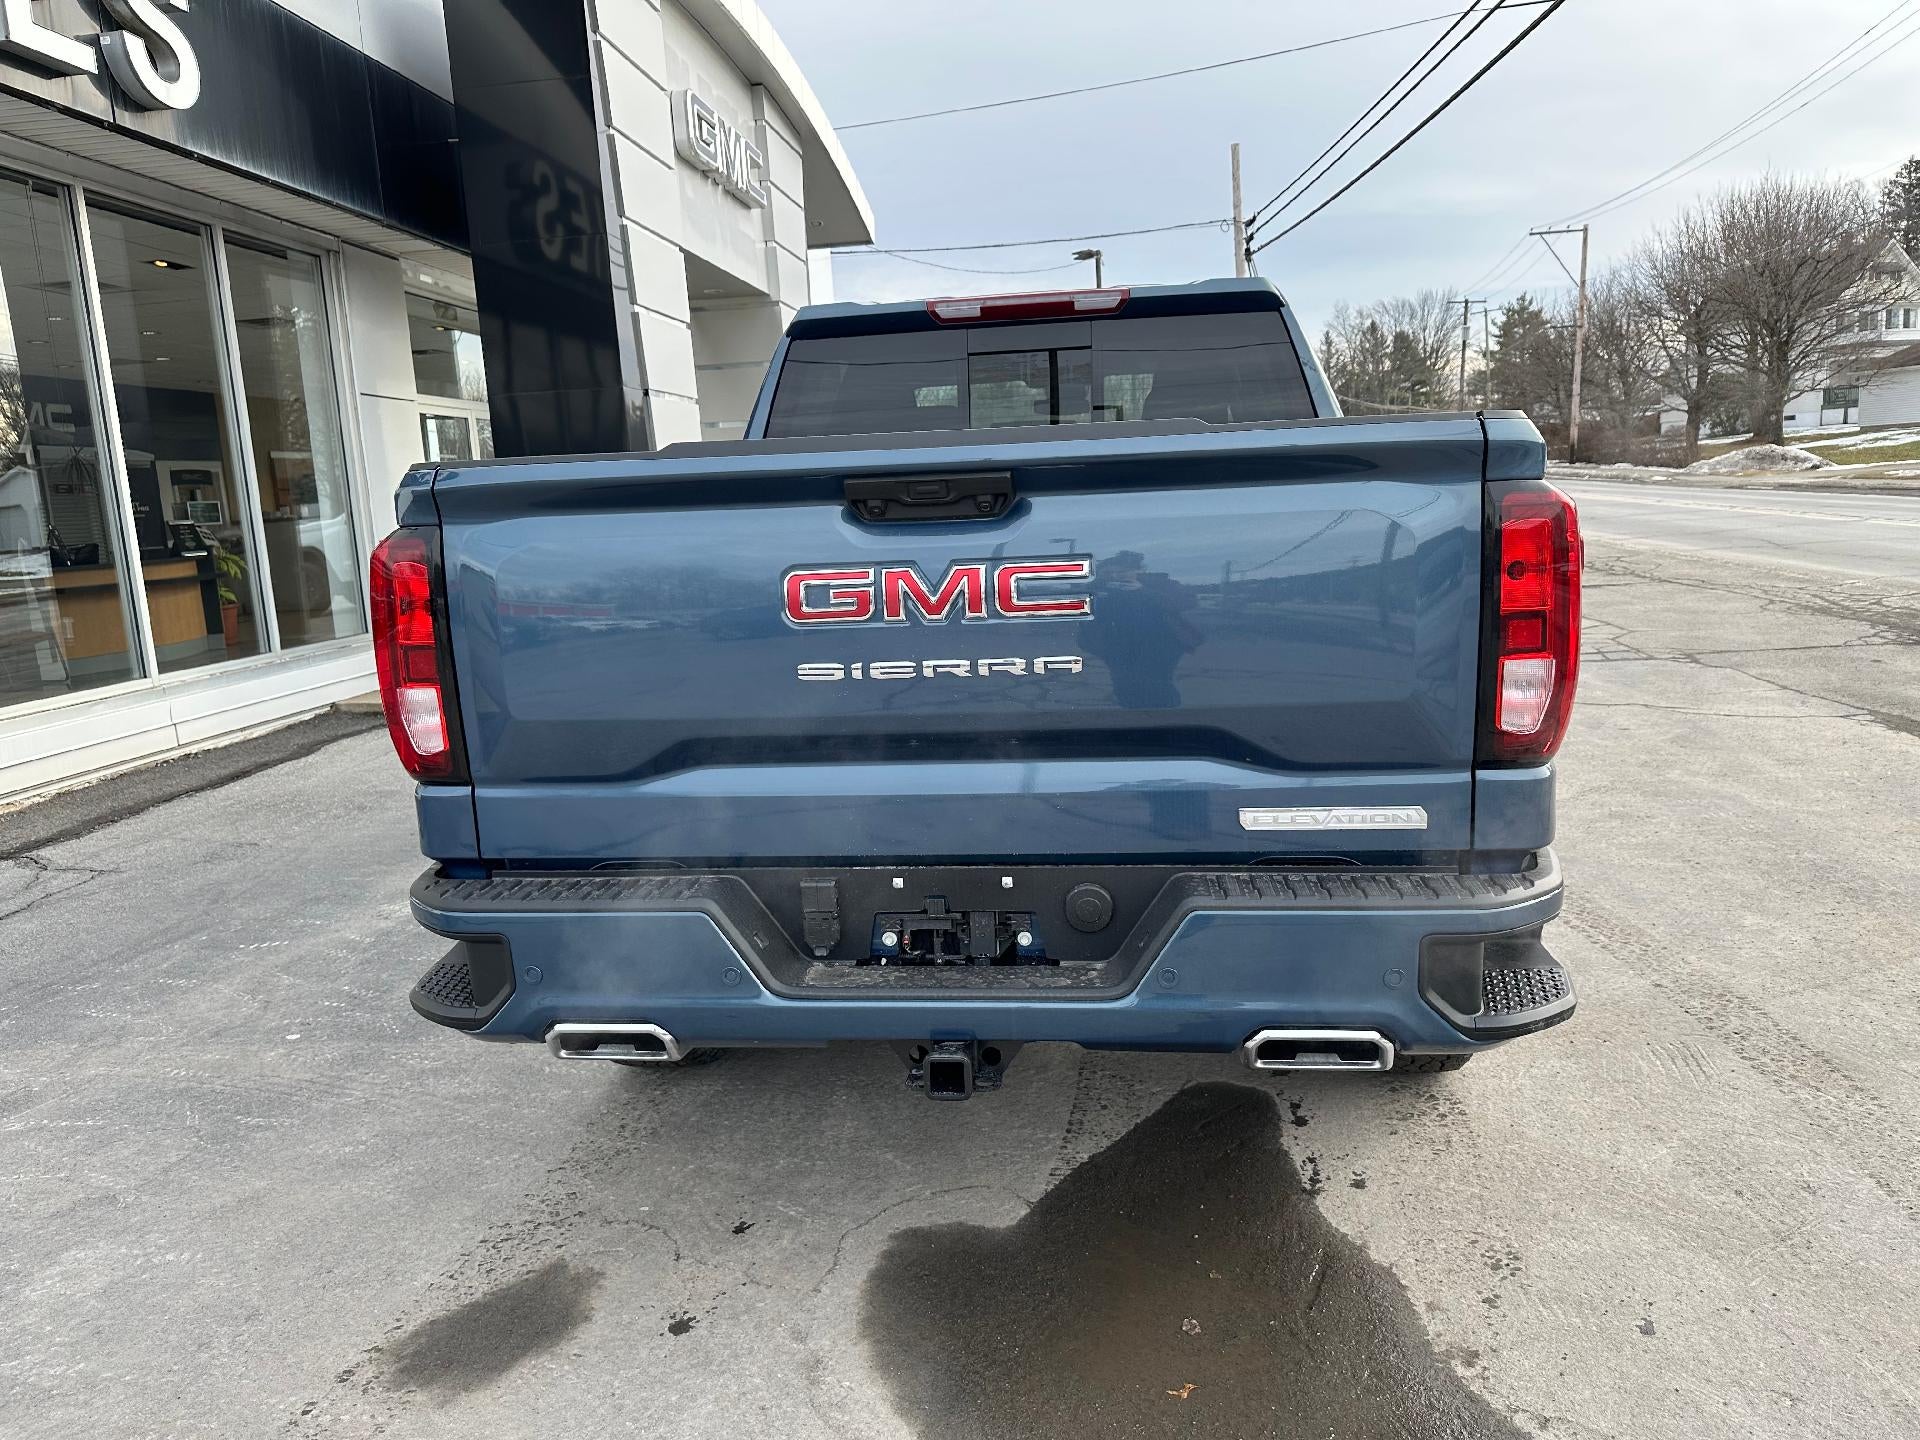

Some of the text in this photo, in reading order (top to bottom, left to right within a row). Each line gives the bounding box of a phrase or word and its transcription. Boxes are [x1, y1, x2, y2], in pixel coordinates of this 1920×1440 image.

[674, 88, 767, 209] GMC
[783, 560, 1091, 624] GMC
[797, 656, 1083, 681] SIERRA
[1253, 812, 1415, 826] ELEVATION
